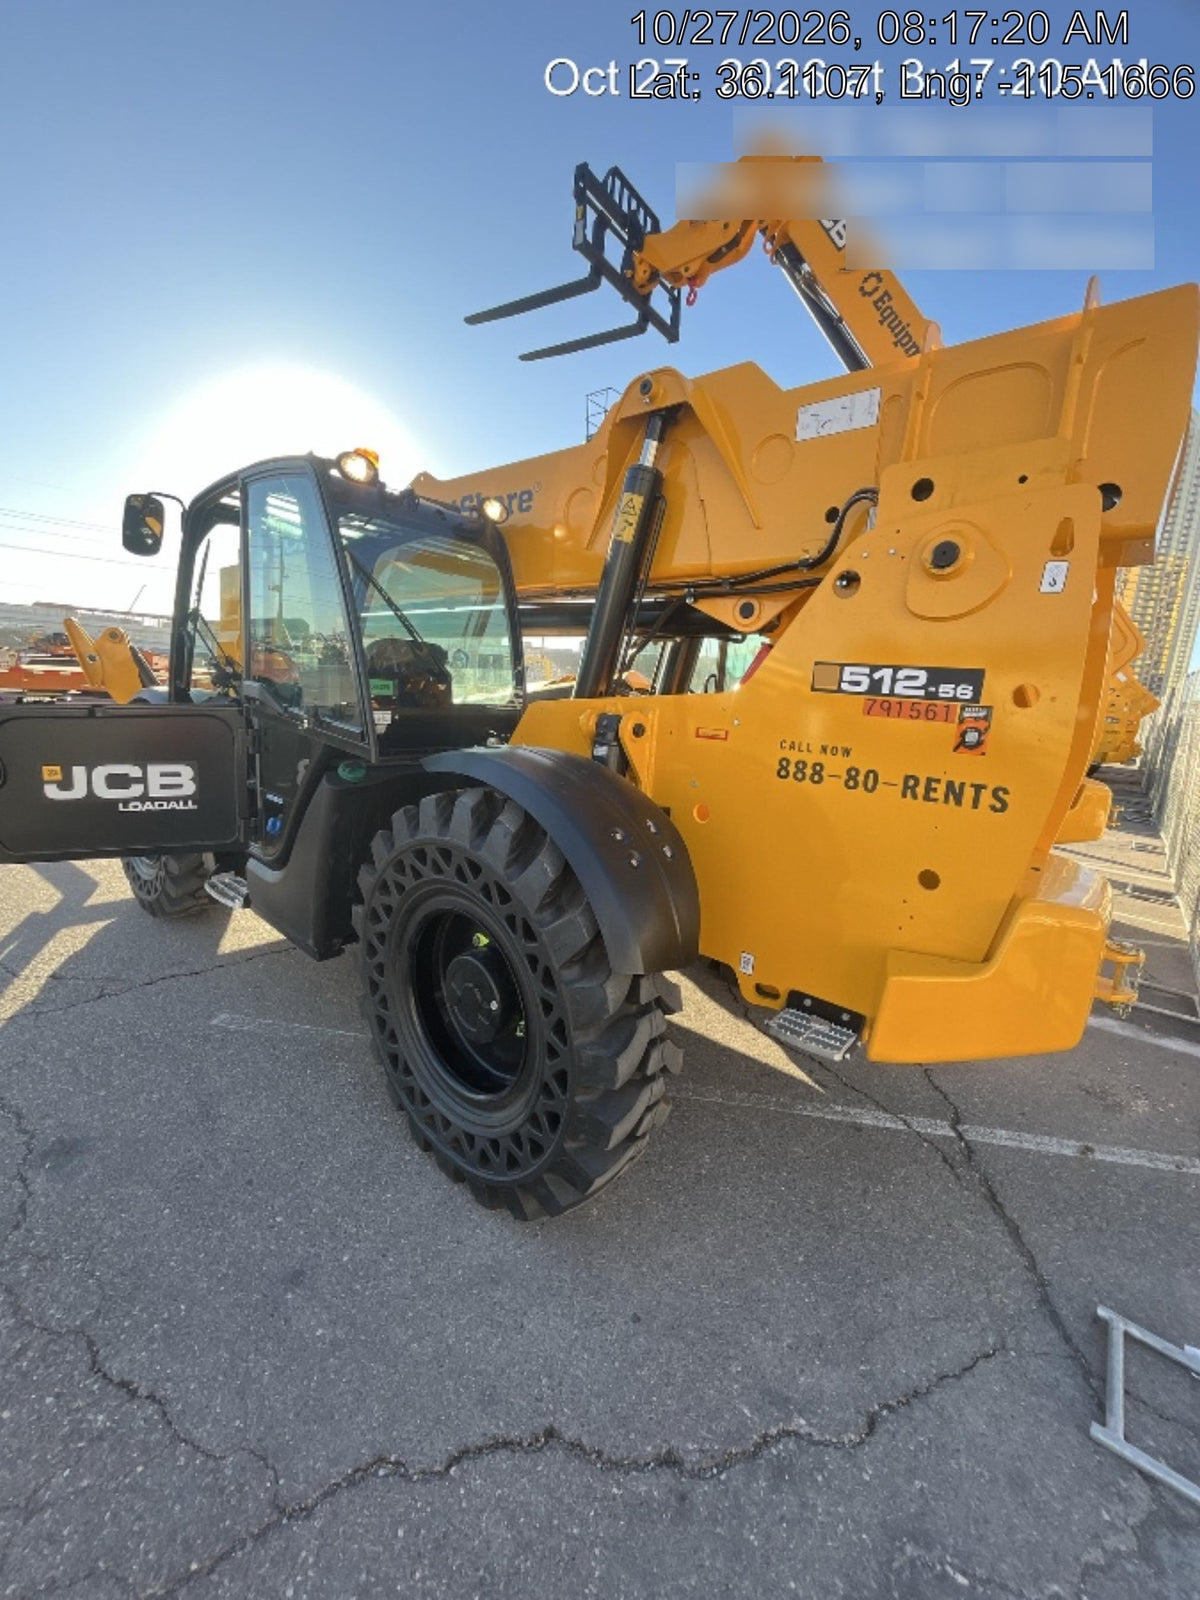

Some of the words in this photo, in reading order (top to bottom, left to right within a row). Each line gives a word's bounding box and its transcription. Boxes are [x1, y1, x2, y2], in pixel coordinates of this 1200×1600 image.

[866, 698, 951, 722] 791561
[780, 739, 812, 753] CALL
[820, 744, 852, 758] NOW
[43, 763, 197, 800] JCB
[776, 757, 1011, 813] 888-80-RENTS
[118, 799, 198, 812] LOADALL
